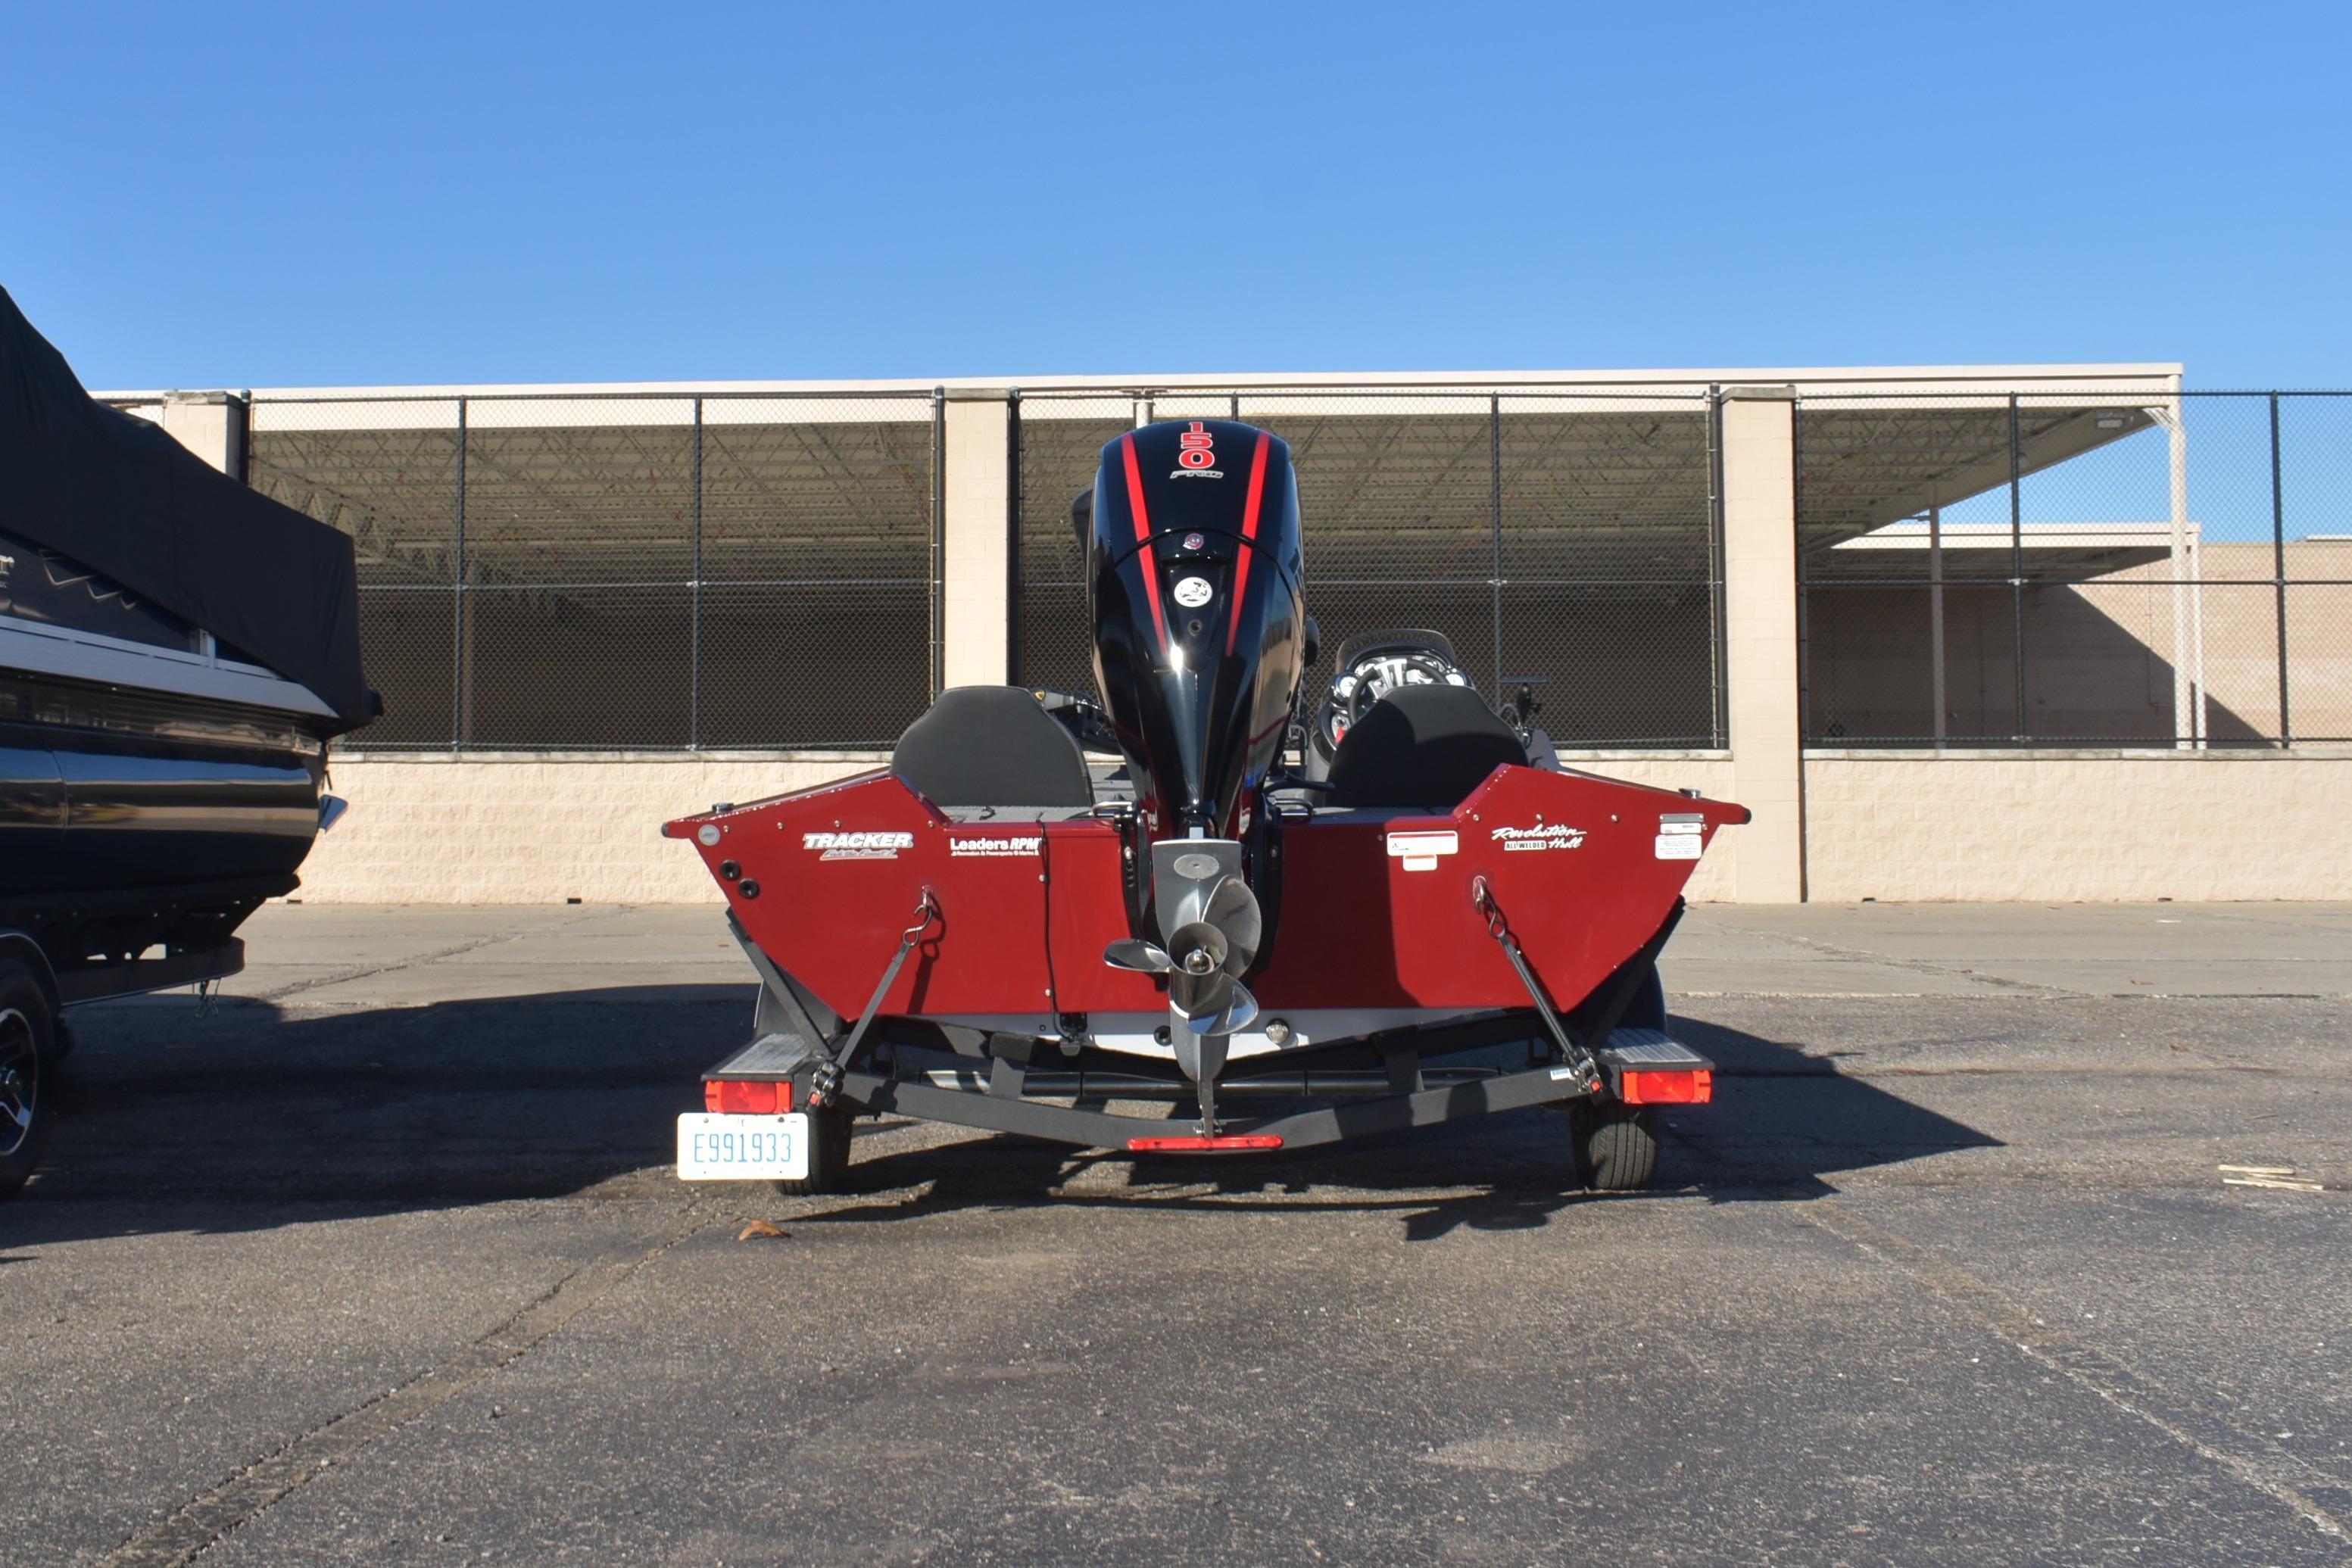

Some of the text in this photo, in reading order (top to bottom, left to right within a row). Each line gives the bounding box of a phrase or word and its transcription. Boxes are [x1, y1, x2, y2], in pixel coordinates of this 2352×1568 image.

[803, 832, 913, 849] TRACKER
[950, 837, 1040, 850] Leaders RPM
[1548, 837, 1583, 849] Hull
[694, 1133, 791, 1163] E991933
